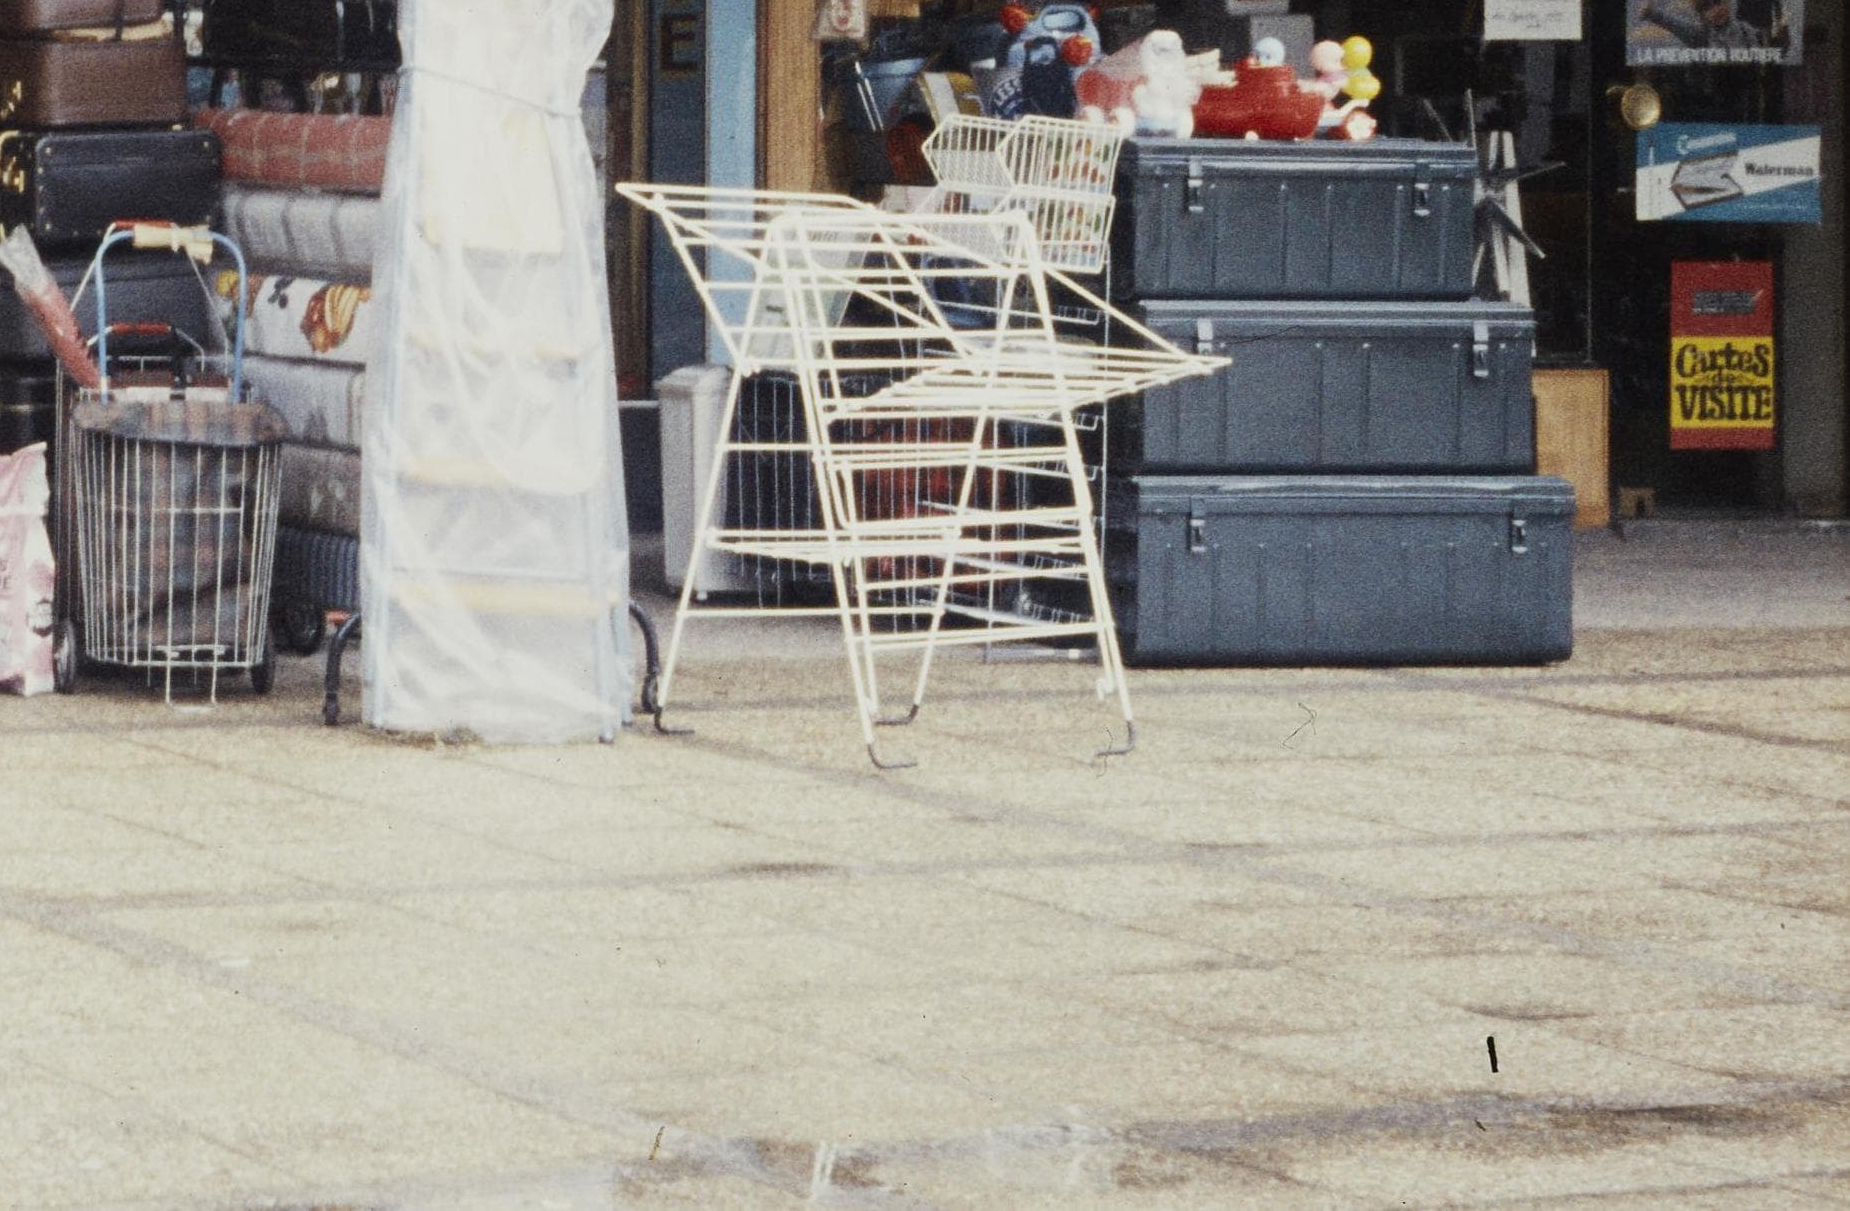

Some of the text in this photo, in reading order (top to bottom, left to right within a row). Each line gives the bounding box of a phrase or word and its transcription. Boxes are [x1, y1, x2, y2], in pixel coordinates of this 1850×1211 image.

[1744, 162, 1814, 177] Waterman
[1675, 342, 1770, 378] Cartes
[1676, 383, 1772, 421] VISITE
